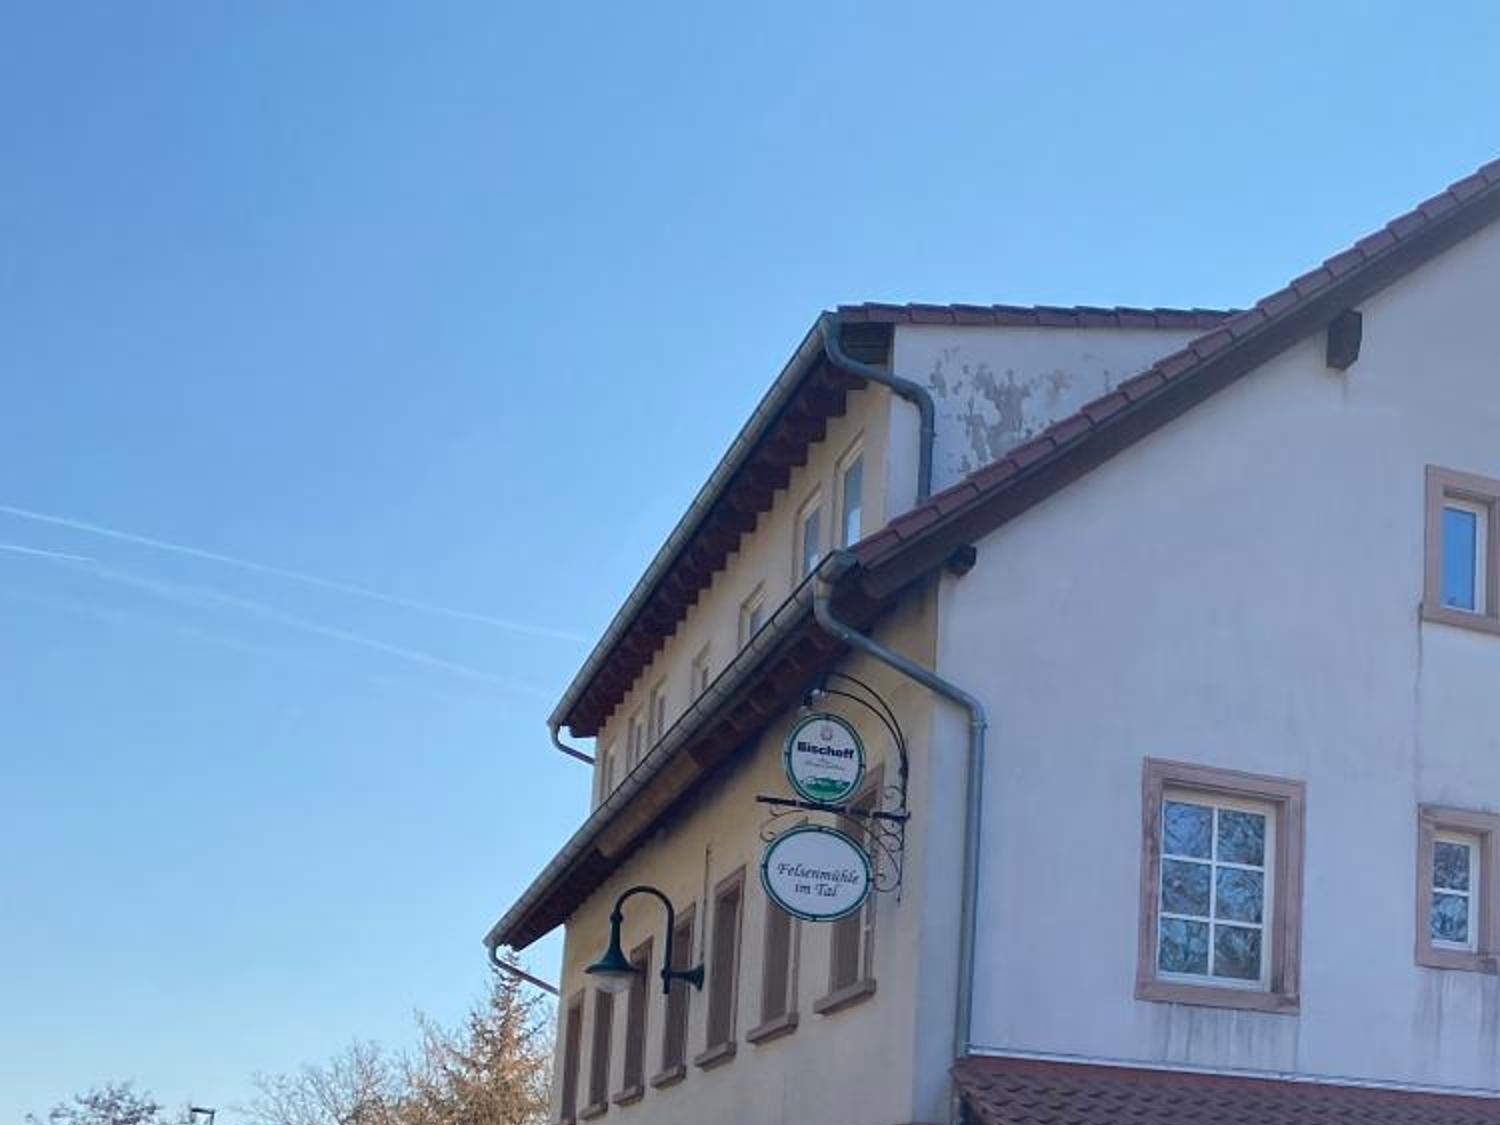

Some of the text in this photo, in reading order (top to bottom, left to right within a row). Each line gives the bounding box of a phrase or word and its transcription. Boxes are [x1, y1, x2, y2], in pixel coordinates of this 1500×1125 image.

[797, 741, 854, 759] Bischoff
[777, 862, 860, 884] Felsenmühle
[795, 882, 838, 897] im Tal
